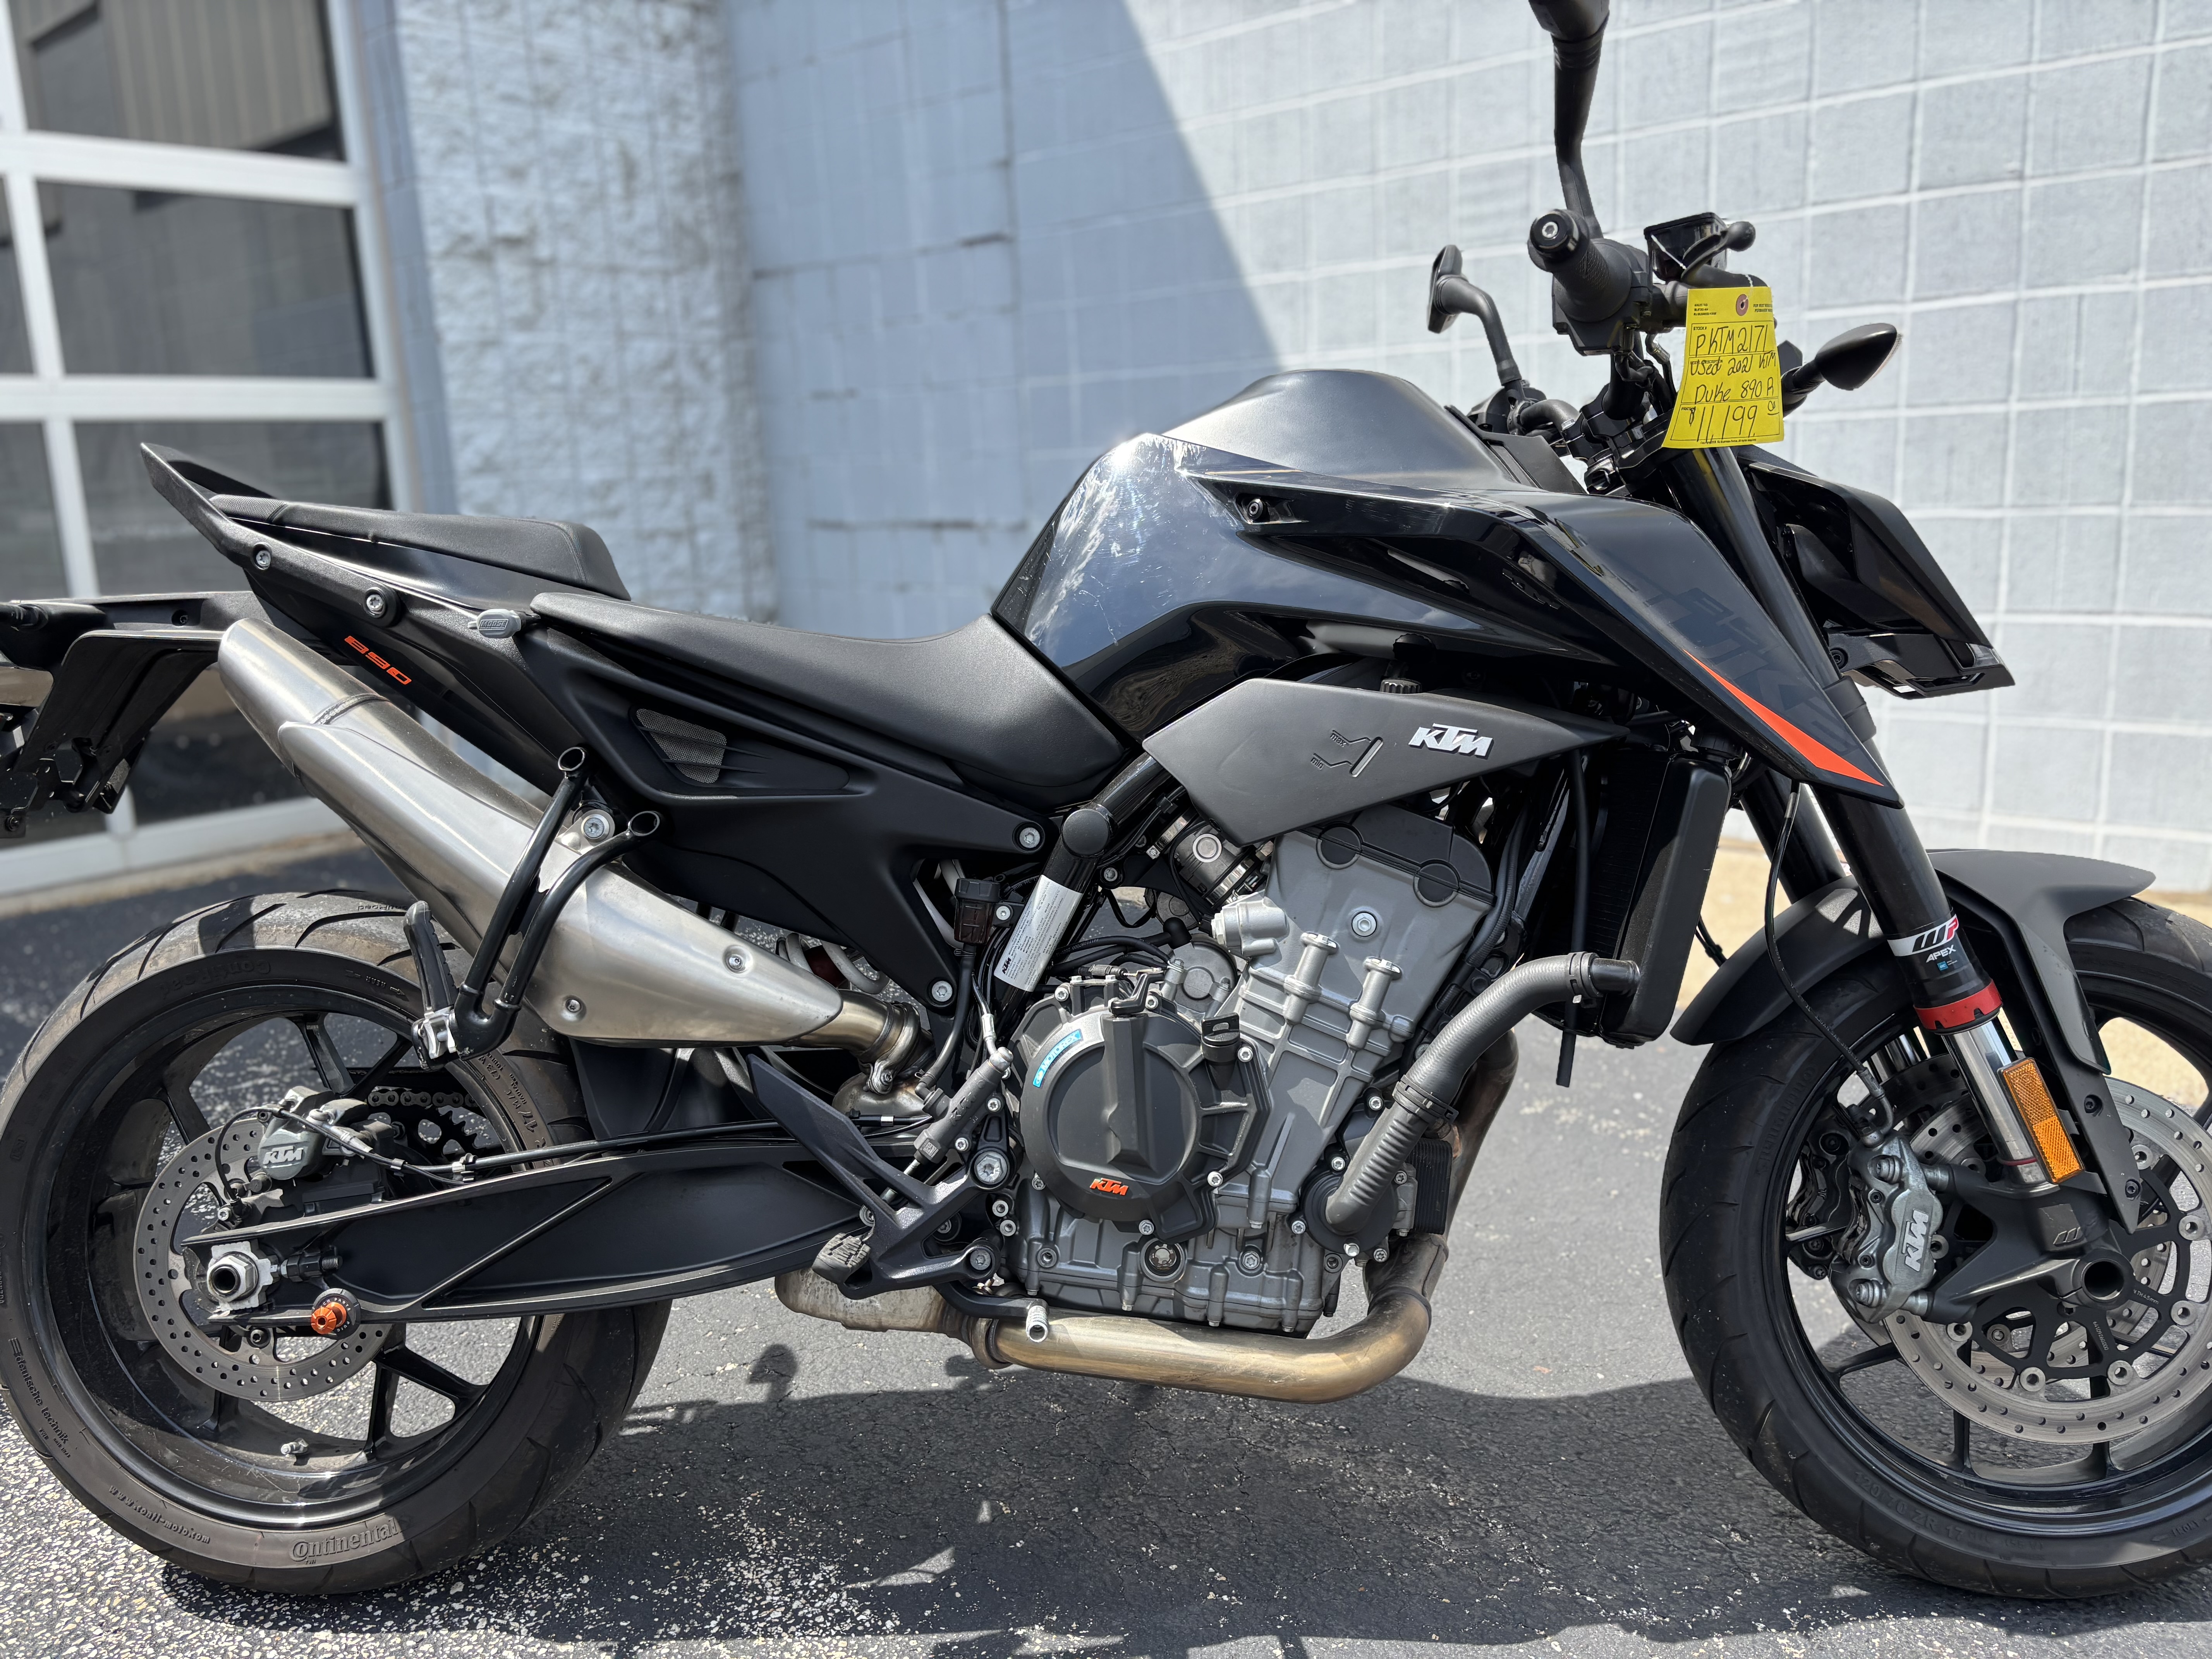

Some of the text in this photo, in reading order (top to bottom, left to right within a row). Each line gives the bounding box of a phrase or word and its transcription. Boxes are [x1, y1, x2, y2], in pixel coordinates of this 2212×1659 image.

[1741, 379, 1762, 399] 890
[344, 635, 412, 685] 890
[1331, 732, 1346, 747] max
[1408, 723, 1494, 757] KTM
[1310, 757, 1324, 770] min
[1926, 945, 1956, 963] APEX
[1002, 957, 1012, 975] KTM
[1041, 1032, 1080, 1070] MOTOREX
[263, 1145, 304, 1164] KTM
[1089, 1177, 1129, 1196] KTM
[1902, 1209, 1929, 1273] KTM
[41, 1406, 70, 1444] technik
[108, 1485, 211, 1544] www.conti-moto.com
[289, 1517, 399, 1562] Continental
[1946, 1525, 1965, 1541] 17
